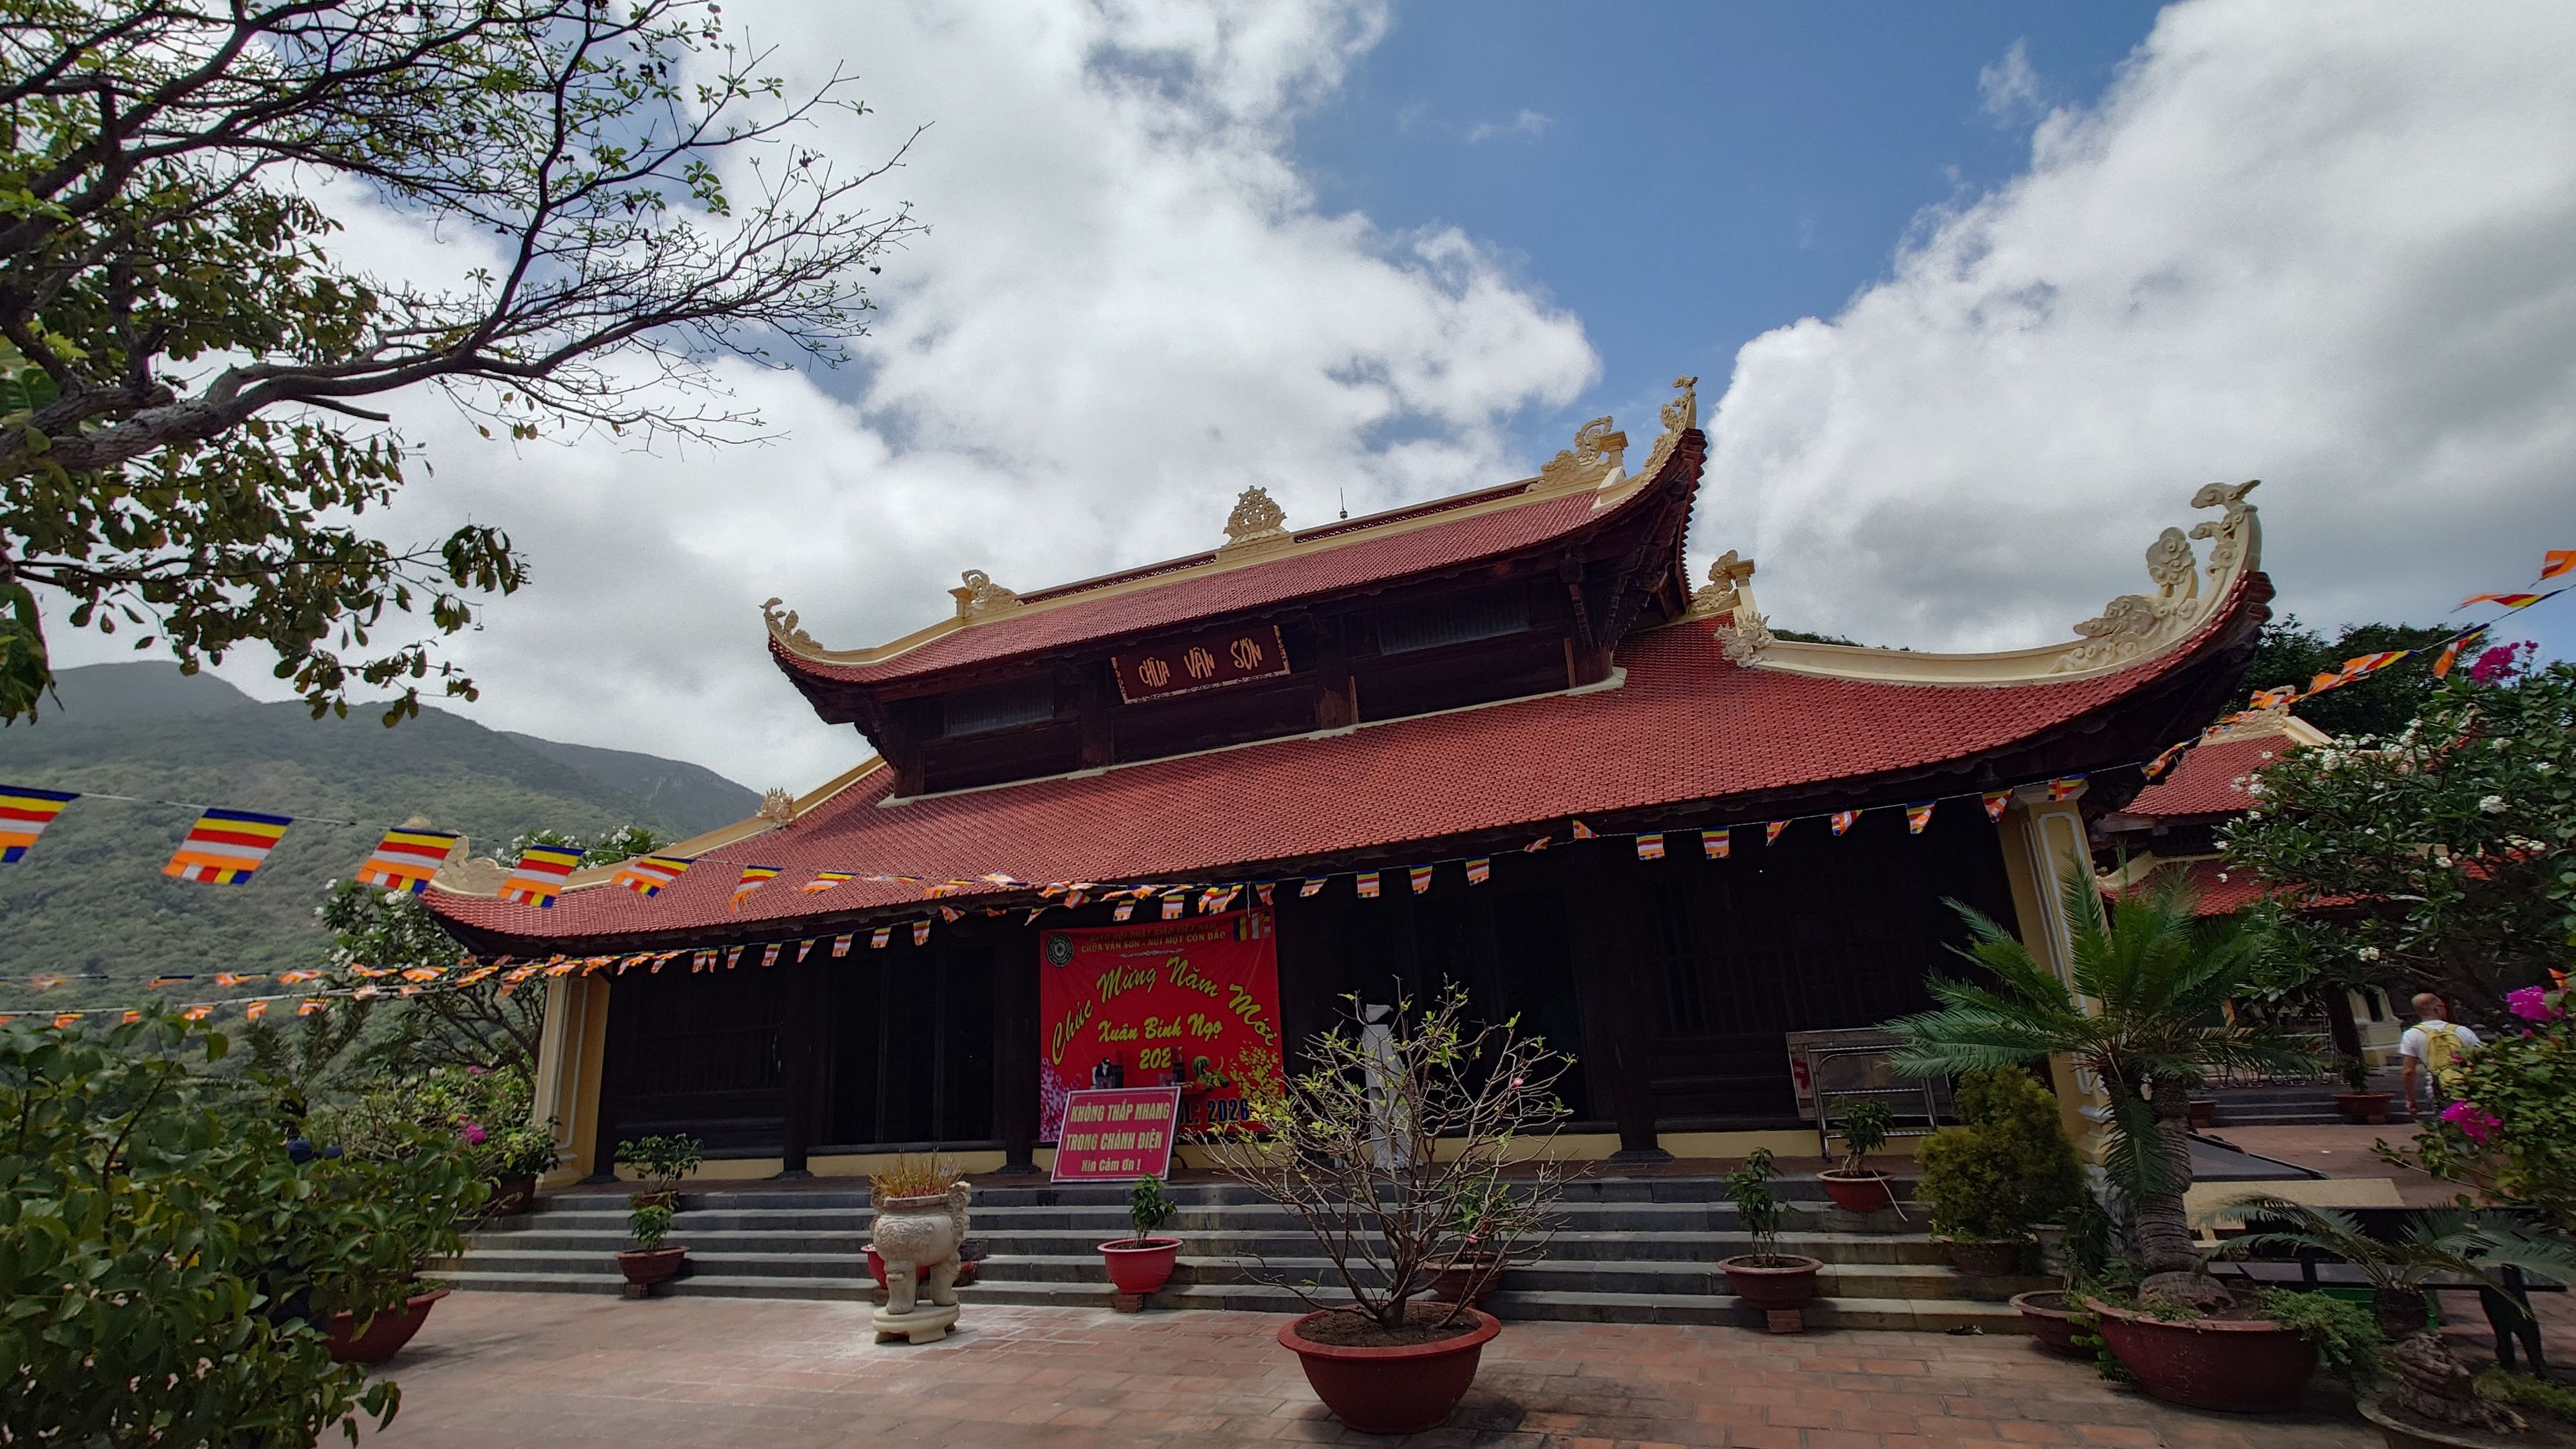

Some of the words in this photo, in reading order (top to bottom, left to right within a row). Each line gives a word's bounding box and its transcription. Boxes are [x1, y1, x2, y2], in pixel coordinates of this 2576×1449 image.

[1139, 657, 1170, 687] CHÙA
[1183, 647, 1216, 679] VÂN
[1230, 637, 1263, 670] SƠN
[1081, 940, 1103, 953] CHÙA
[1105, 938, 1121, 951] VÂN
[1186, 932, 1205, 943] CÔN
[1052, 999, 1093, 1065] Chúc
[1096, 965, 1158, 1004] Mừng
[1166, 956, 1218, 998] Năm
[1228, 983, 1278, 1046] Mới
[1097, 1020, 1138, 1042] Xuân
[1144, 1016, 1182, 1038] Bính
[1187, 1013, 1223, 1042] Ngọ
[1138, 1044, 1183, 1070] 202
[1070, 1102, 1105, 1122] KHÔNG
[1107, 1098, 1134, 1122] THẮP
[1134, 1102, 1171, 1120] NHANG
[1206, 1097, 1251, 1123] 2026
[1065, 1134, 1098, 1151] TRONG
[1100, 1129, 1136, 1150] CHÁNH
[1137, 1128, 1163, 1153] ĐIỆN
[1081, 1159, 1096, 1172] Xin
[1099, 1157, 1120, 1172] Cảm
